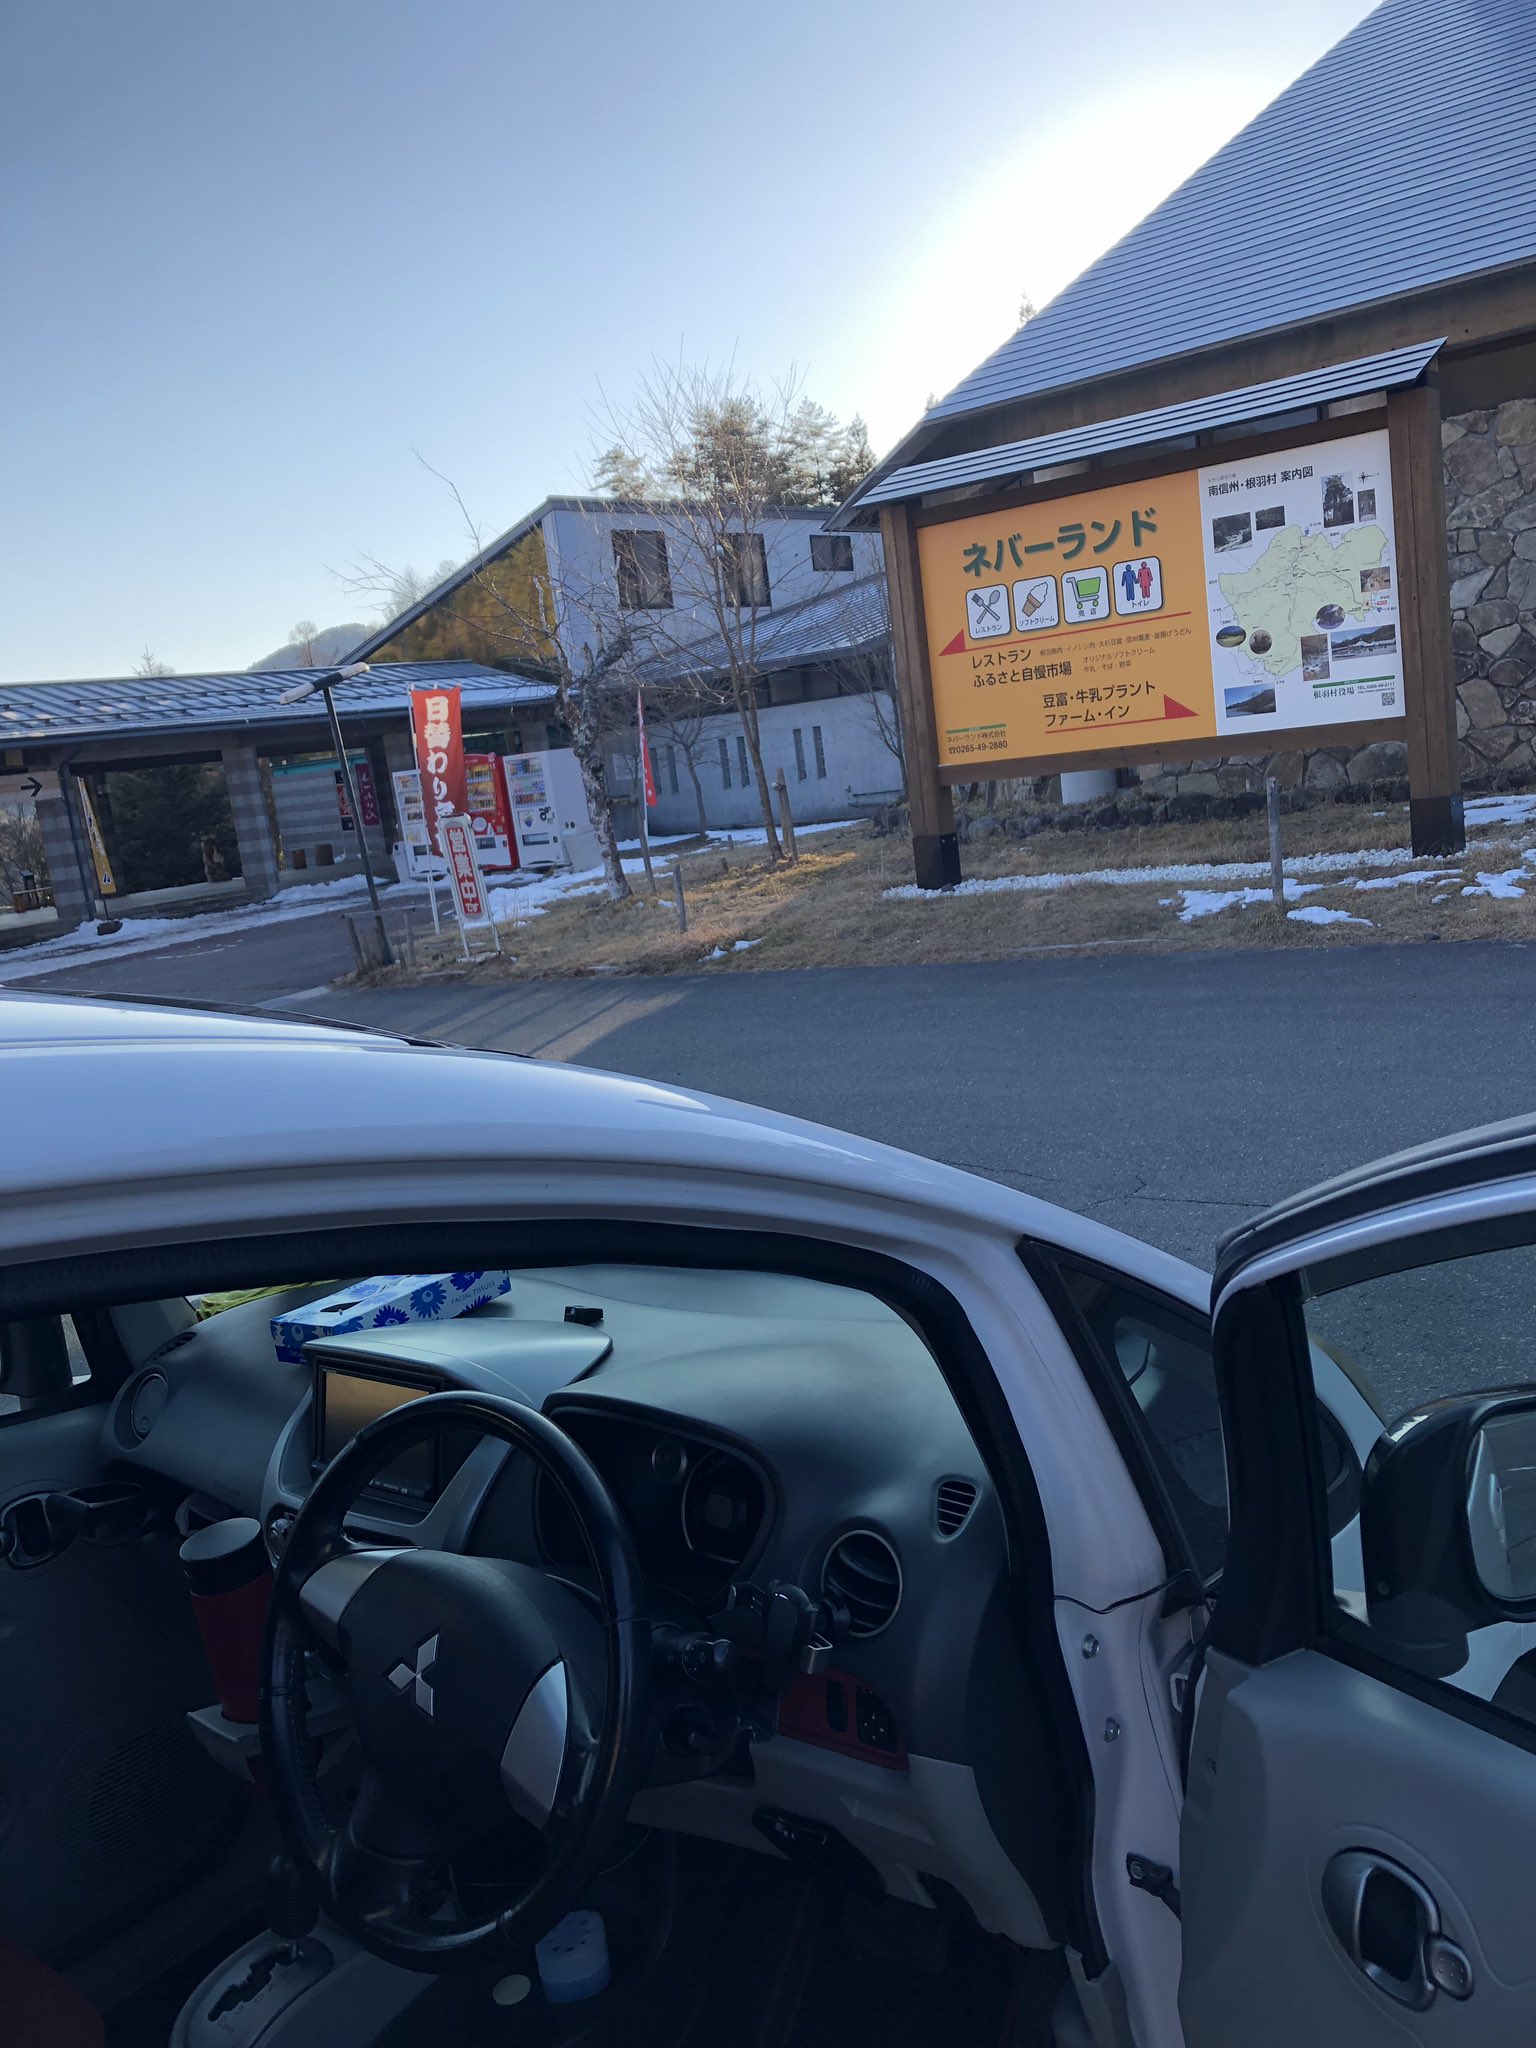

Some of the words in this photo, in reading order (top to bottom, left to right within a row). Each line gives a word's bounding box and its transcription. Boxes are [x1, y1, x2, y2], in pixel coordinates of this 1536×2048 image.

[1208, 474, 1277, 497] 南信州・根羽村
[1280, 465, 1314, 483] 案内図
[963, 507, 1158, 577] ネバーランド
[1131, 599, 1150, 609] トイレ
[975, 624, 1003, 634] レストラン
[1019, 615, 1056, 627] ソフトクリーム
[972, 649, 1032, 669] レストラン
[1083, 647, 1155, 663] オリジナルソフトクリーム
[973, 661, 1072, 688] ふるさと自慢市場
[1043, 681, 1156, 708] 豆富・牛乳プラント
[1313, 687, 1355, 699] 根羽村役場
[1045, 705, 1130, 727] ファーム・イン
[947, 730, 1006, 743] ネバーランド株式会社
[450, 828, 479, 913] 営業中です
[451, 1293, 471, 1304] FACIAL
[473, 1280, 496, 1295] TISSUES
